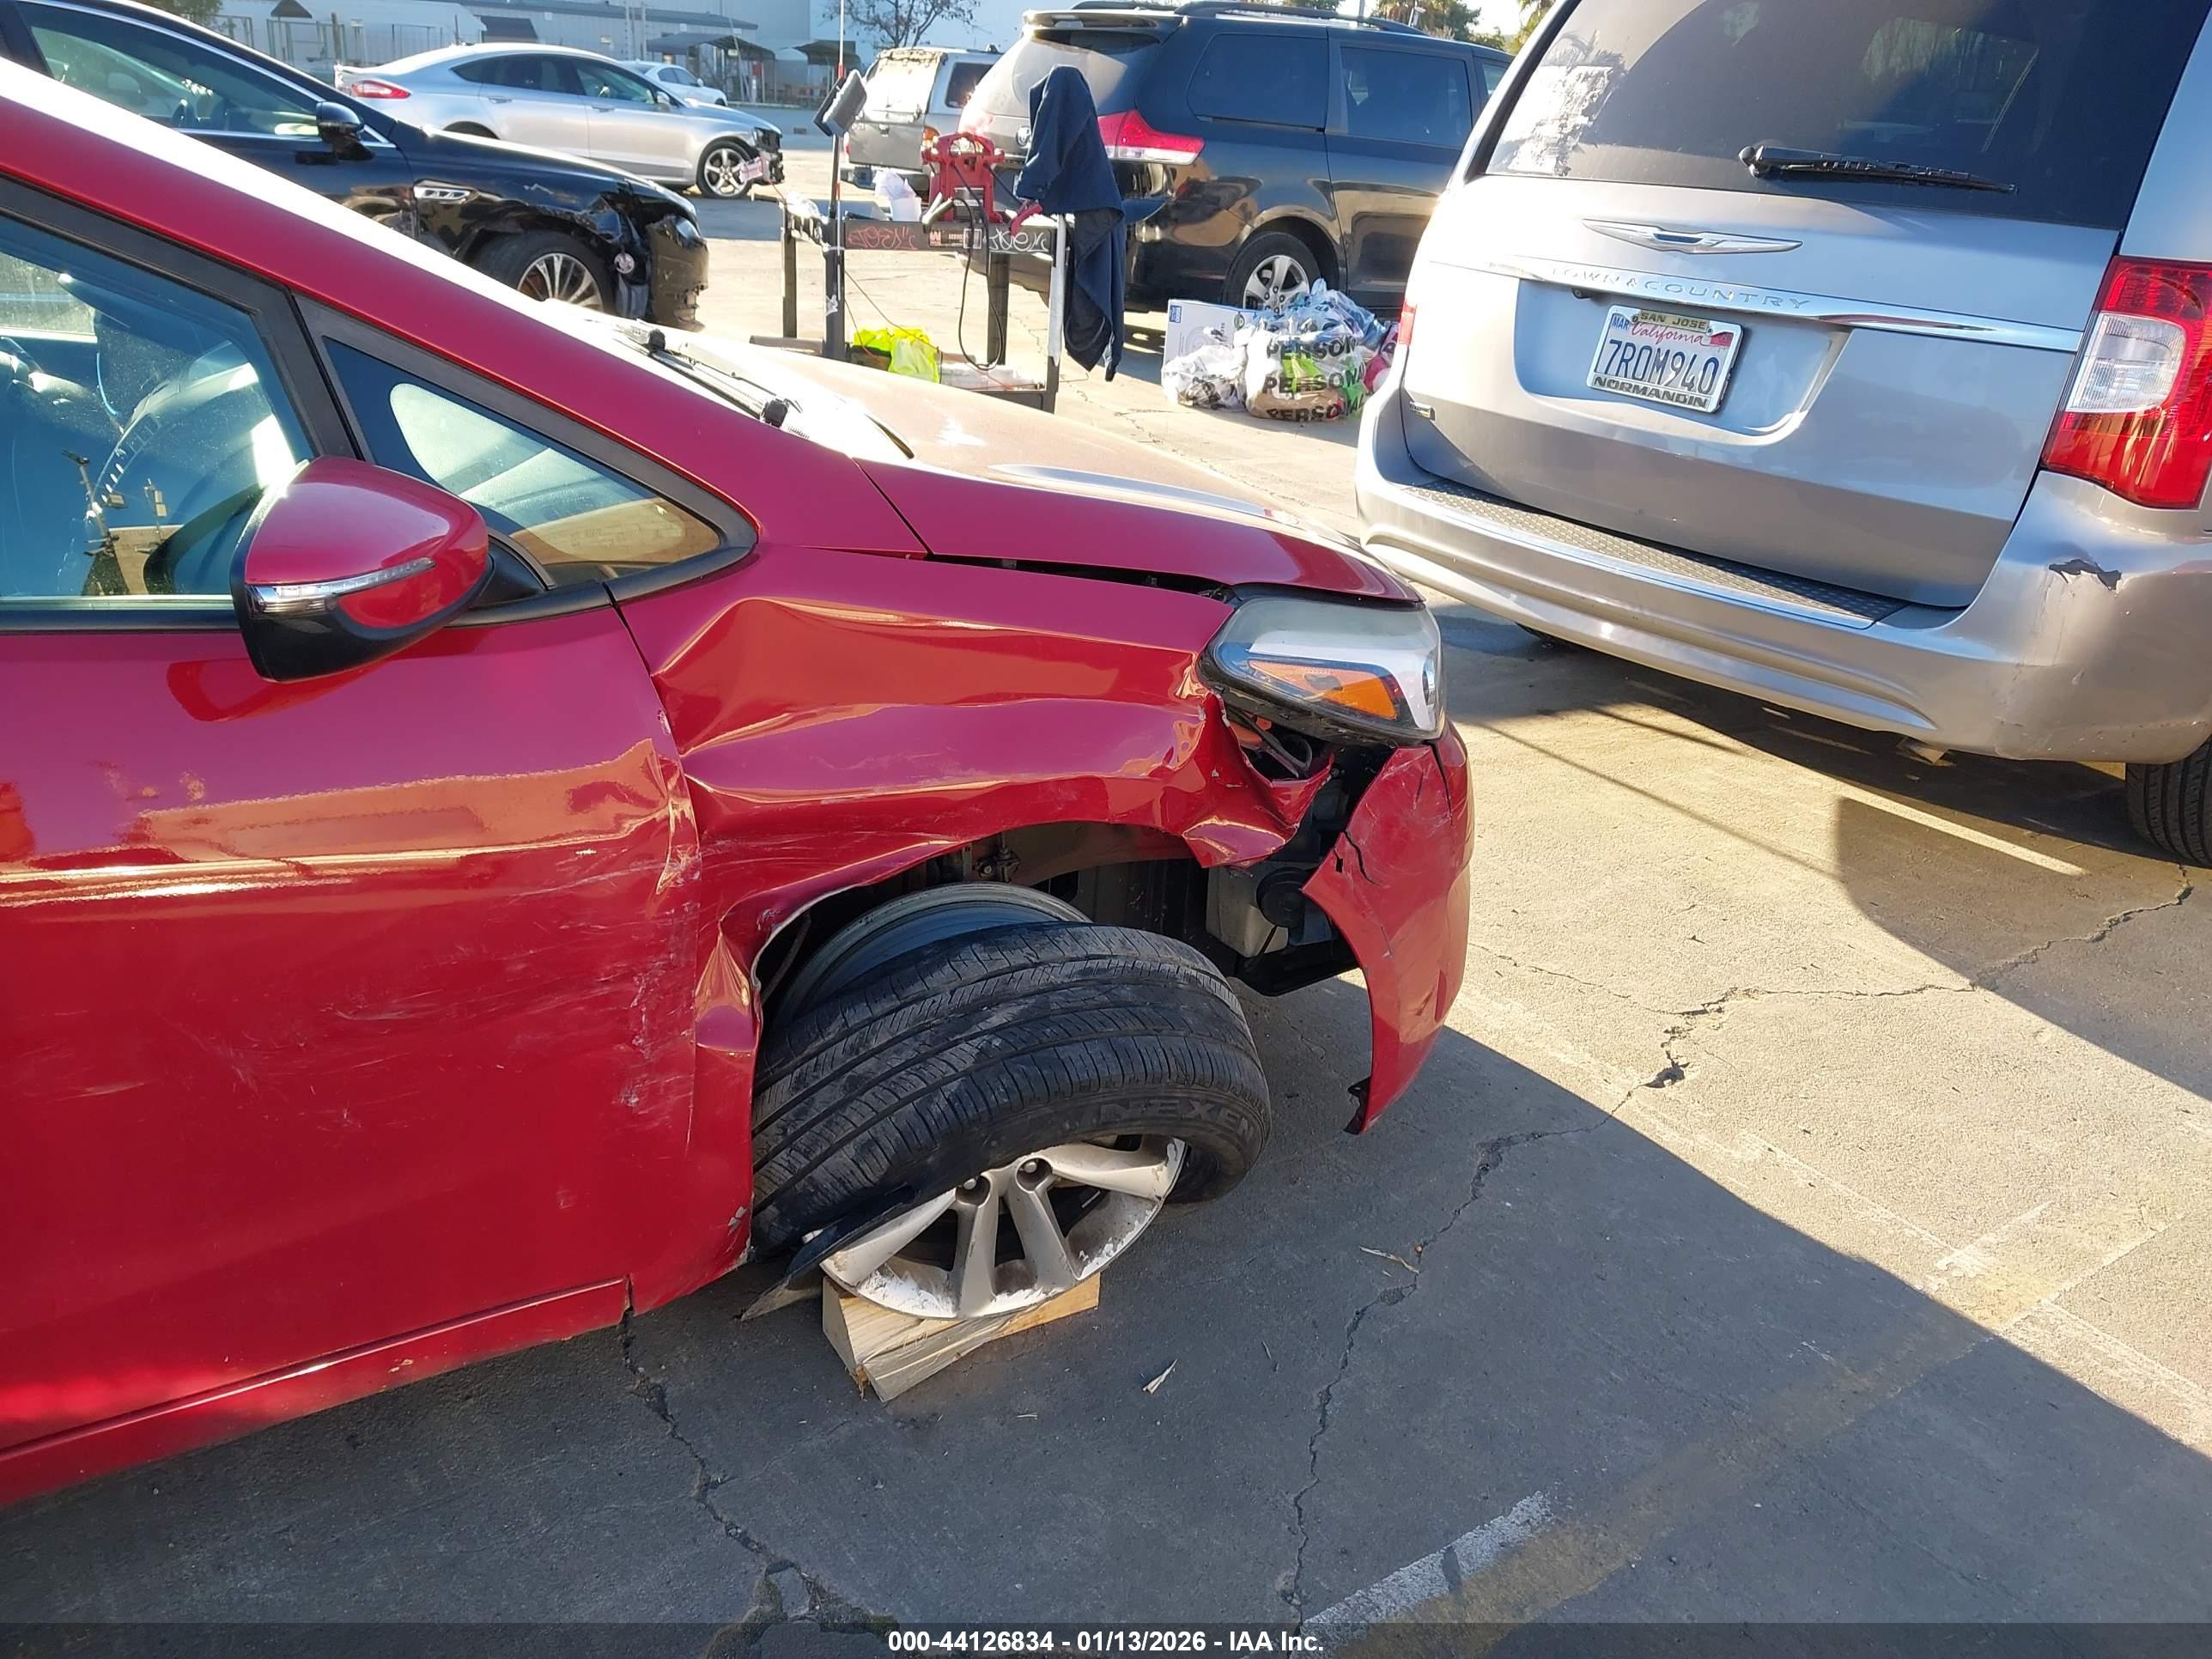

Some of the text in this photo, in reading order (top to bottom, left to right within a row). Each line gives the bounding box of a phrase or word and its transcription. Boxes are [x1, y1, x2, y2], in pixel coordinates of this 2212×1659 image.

[1644, 280, 1810, 310] COUNTRY
[1611, 315, 1629, 331] MAR
[1631, 320, 1711, 347] California
[1640, 312, 1707, 331] SAN JOSE
[1594, 375, 1708, 409] NORMANDIN
